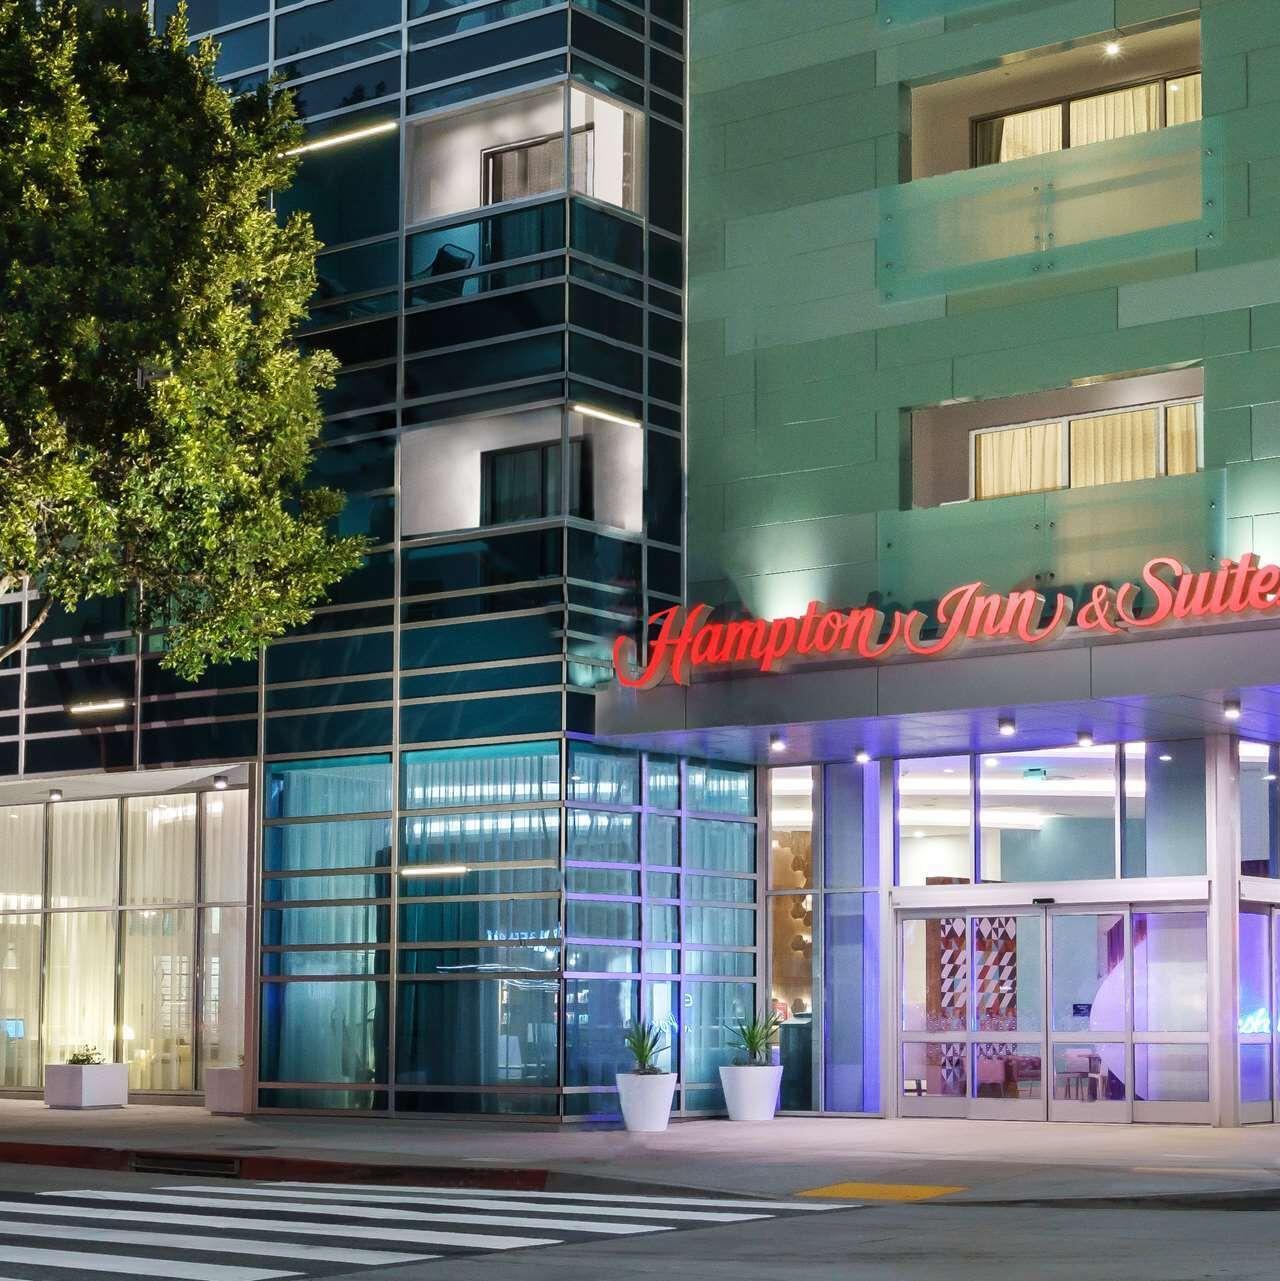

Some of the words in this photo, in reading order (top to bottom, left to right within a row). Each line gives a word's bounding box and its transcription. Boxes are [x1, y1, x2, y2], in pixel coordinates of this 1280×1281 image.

[612, 603, 902, 688] Hampton
[904, 582, 1065, 654] Inn
[1076, 584, 1128, 634] &
